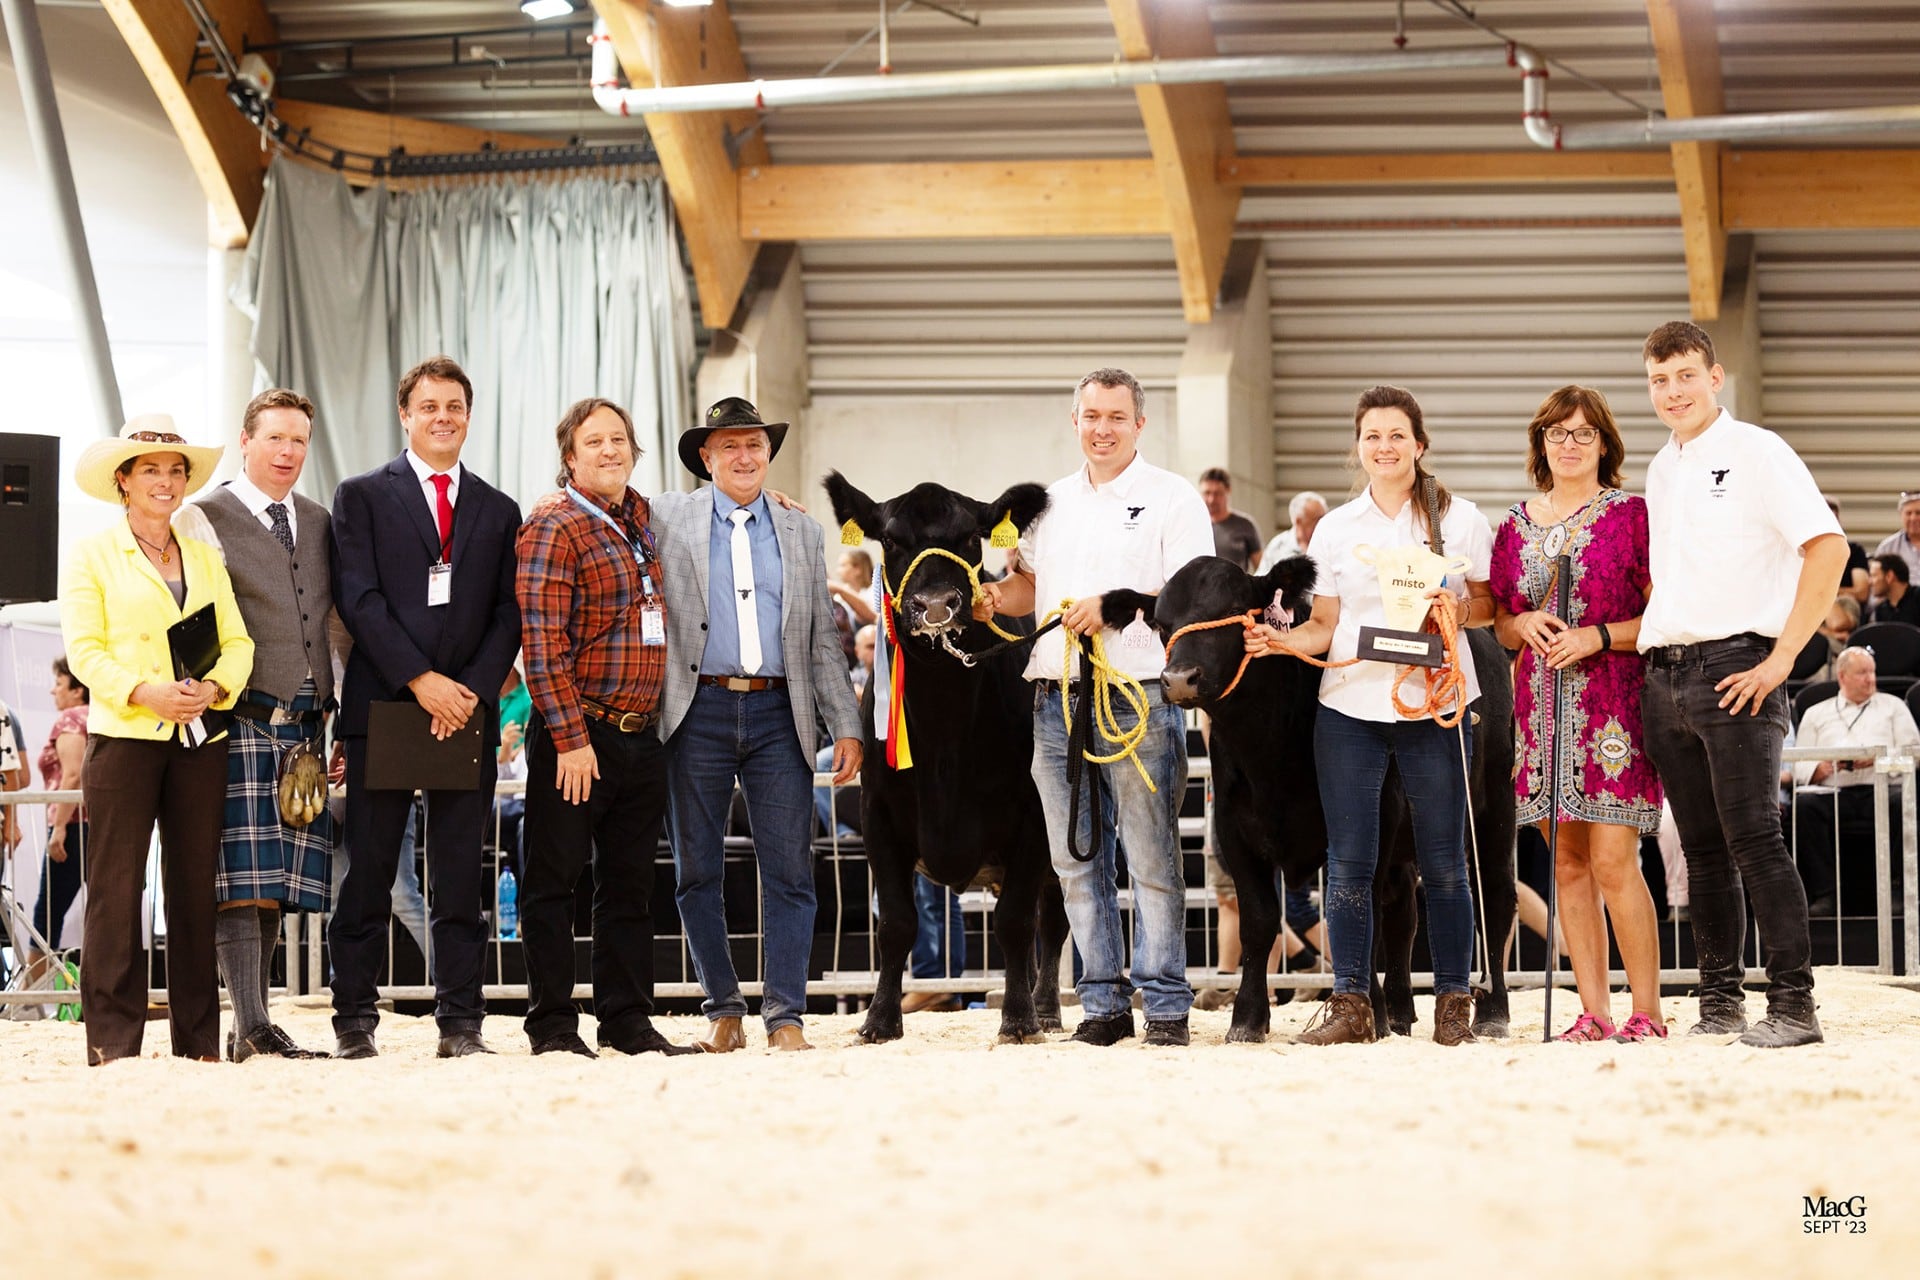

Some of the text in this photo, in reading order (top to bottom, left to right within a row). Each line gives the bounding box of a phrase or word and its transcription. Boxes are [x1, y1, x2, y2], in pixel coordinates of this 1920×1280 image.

[992, 534, 1016, 547] 765310
[1407, 564, 1414, 575] 1.
[1391, 577, 1426, 589] místo
